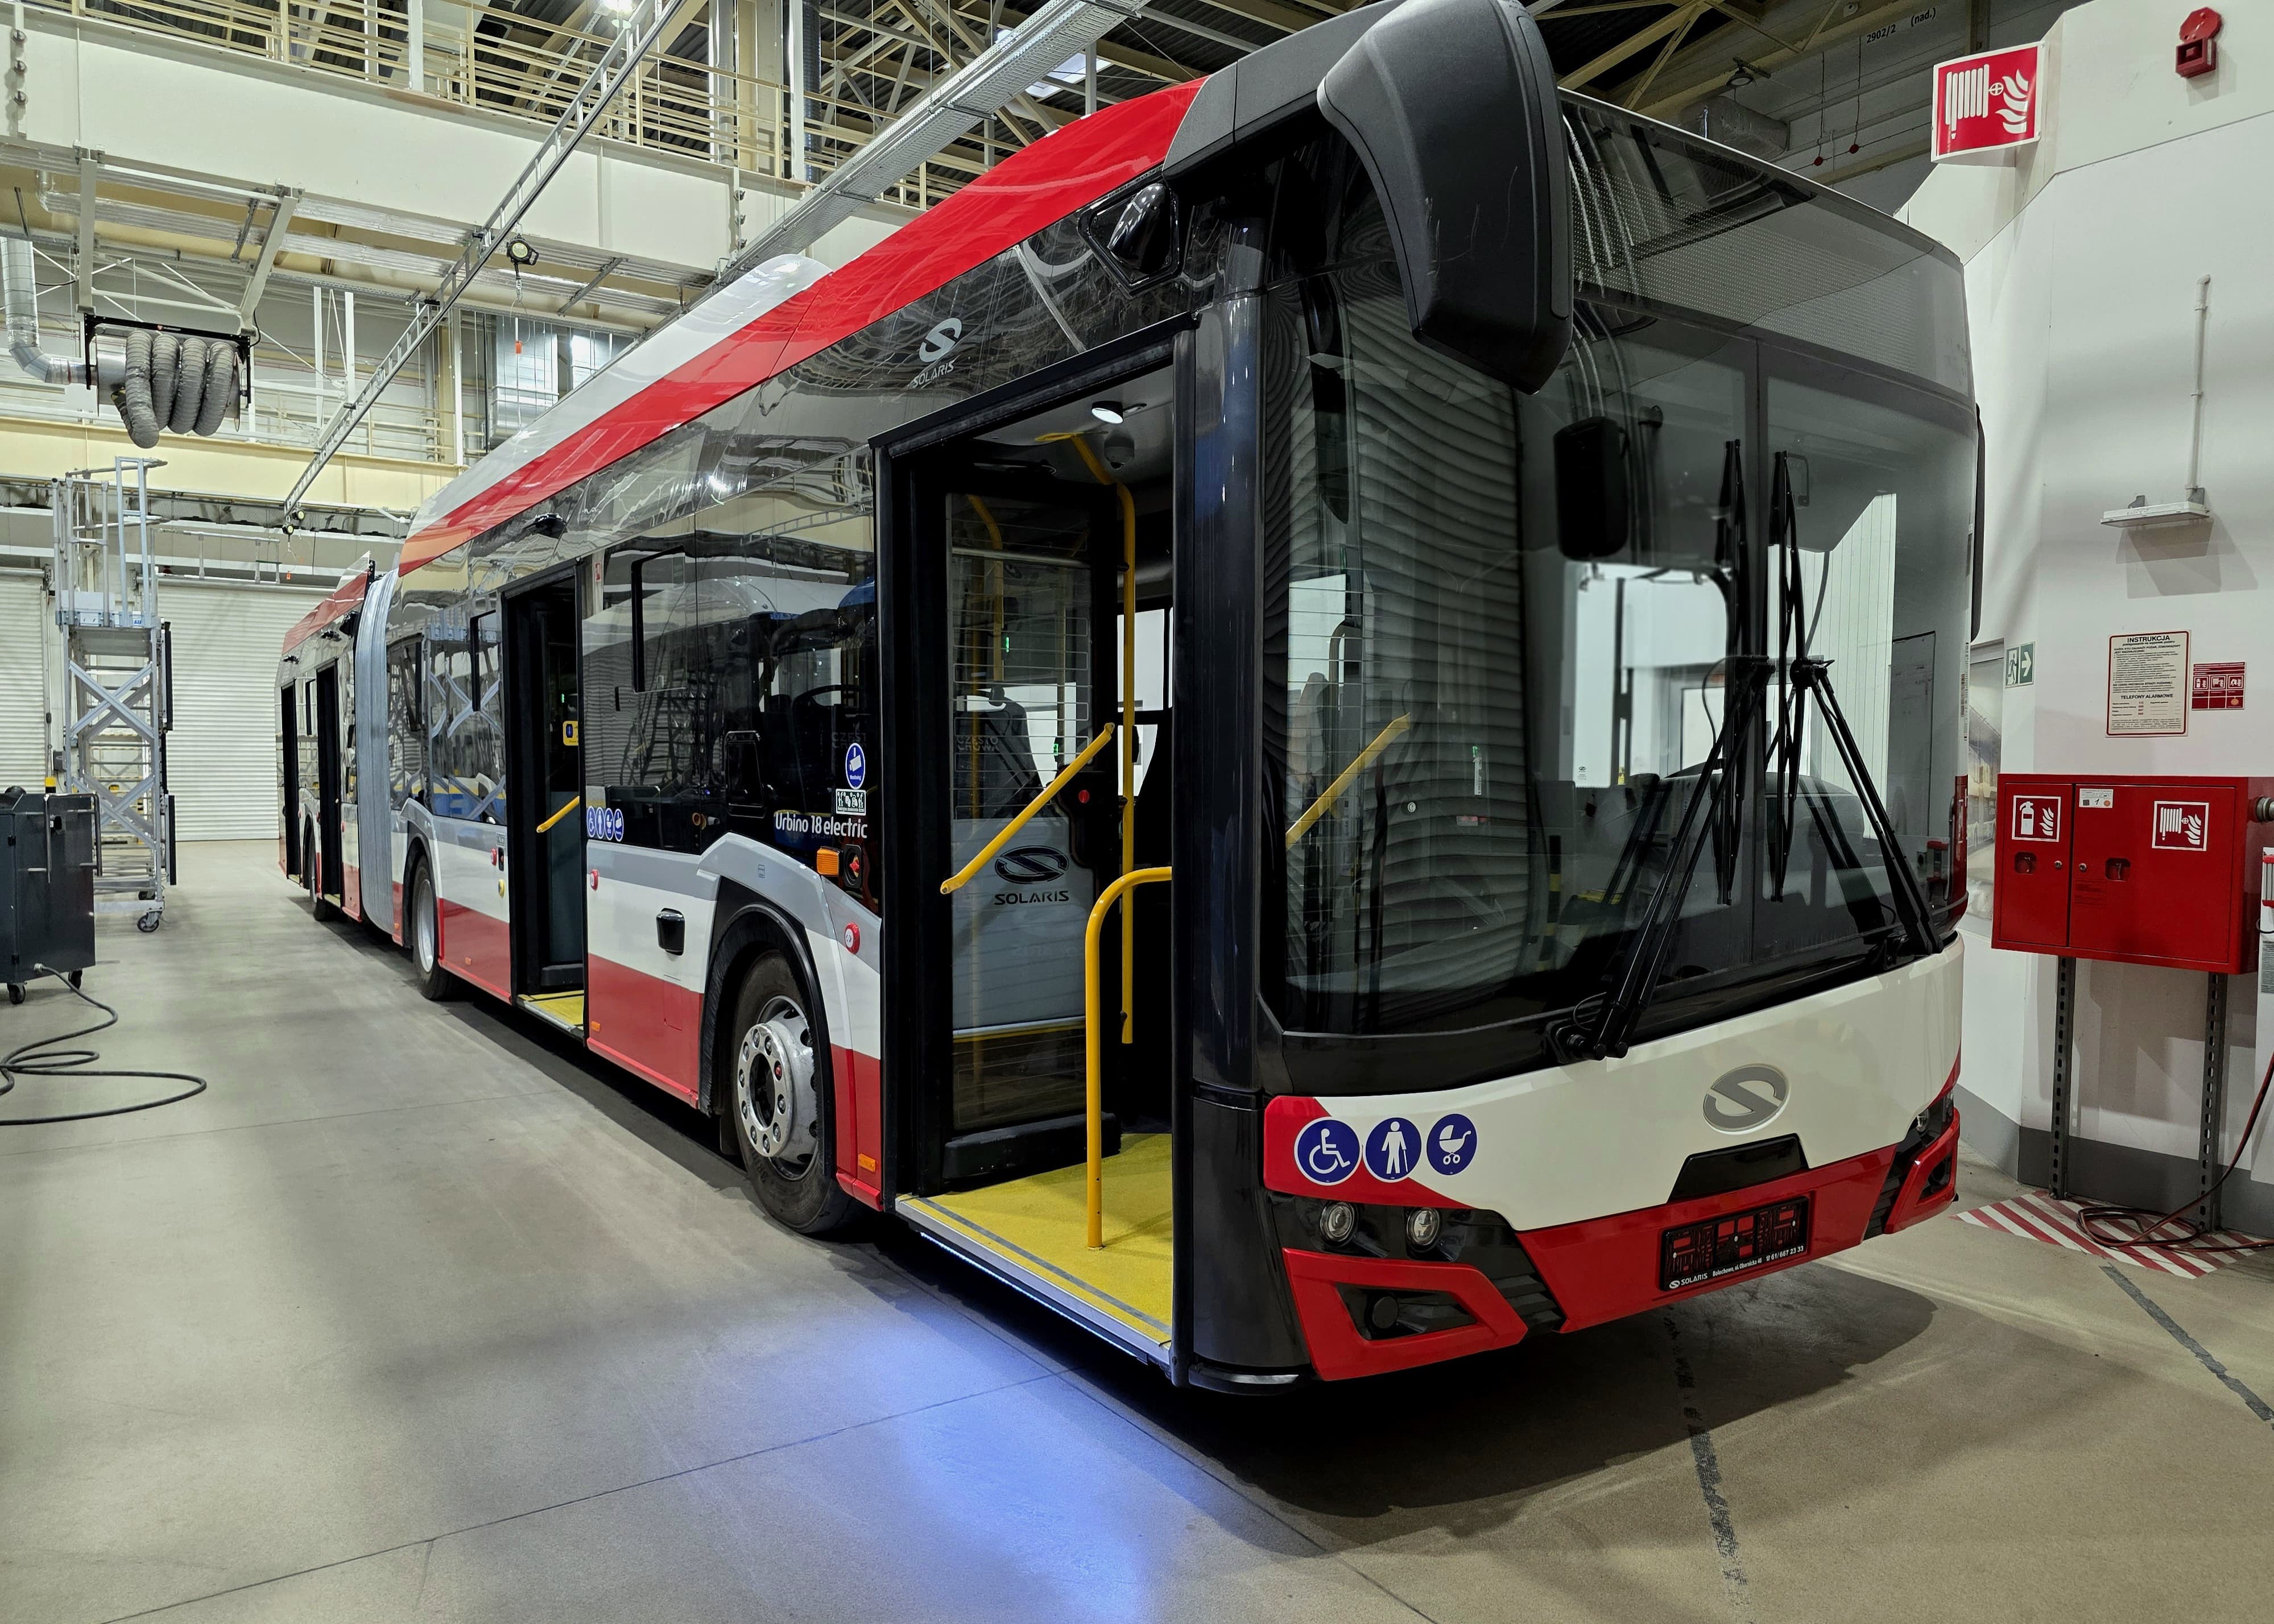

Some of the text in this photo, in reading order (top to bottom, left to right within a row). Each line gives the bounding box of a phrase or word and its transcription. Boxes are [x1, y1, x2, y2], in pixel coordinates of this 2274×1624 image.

[1867, 7, 1936, 43] 2902/2 (nad.)
[911, 361, 954, 389] SOLARIS
[776, 812, 868, 839] Urbino 18 electric
[994, 890, 1069, 905] SOLARIS
[1681, 1273, 1708, 1286] SOLARIS
